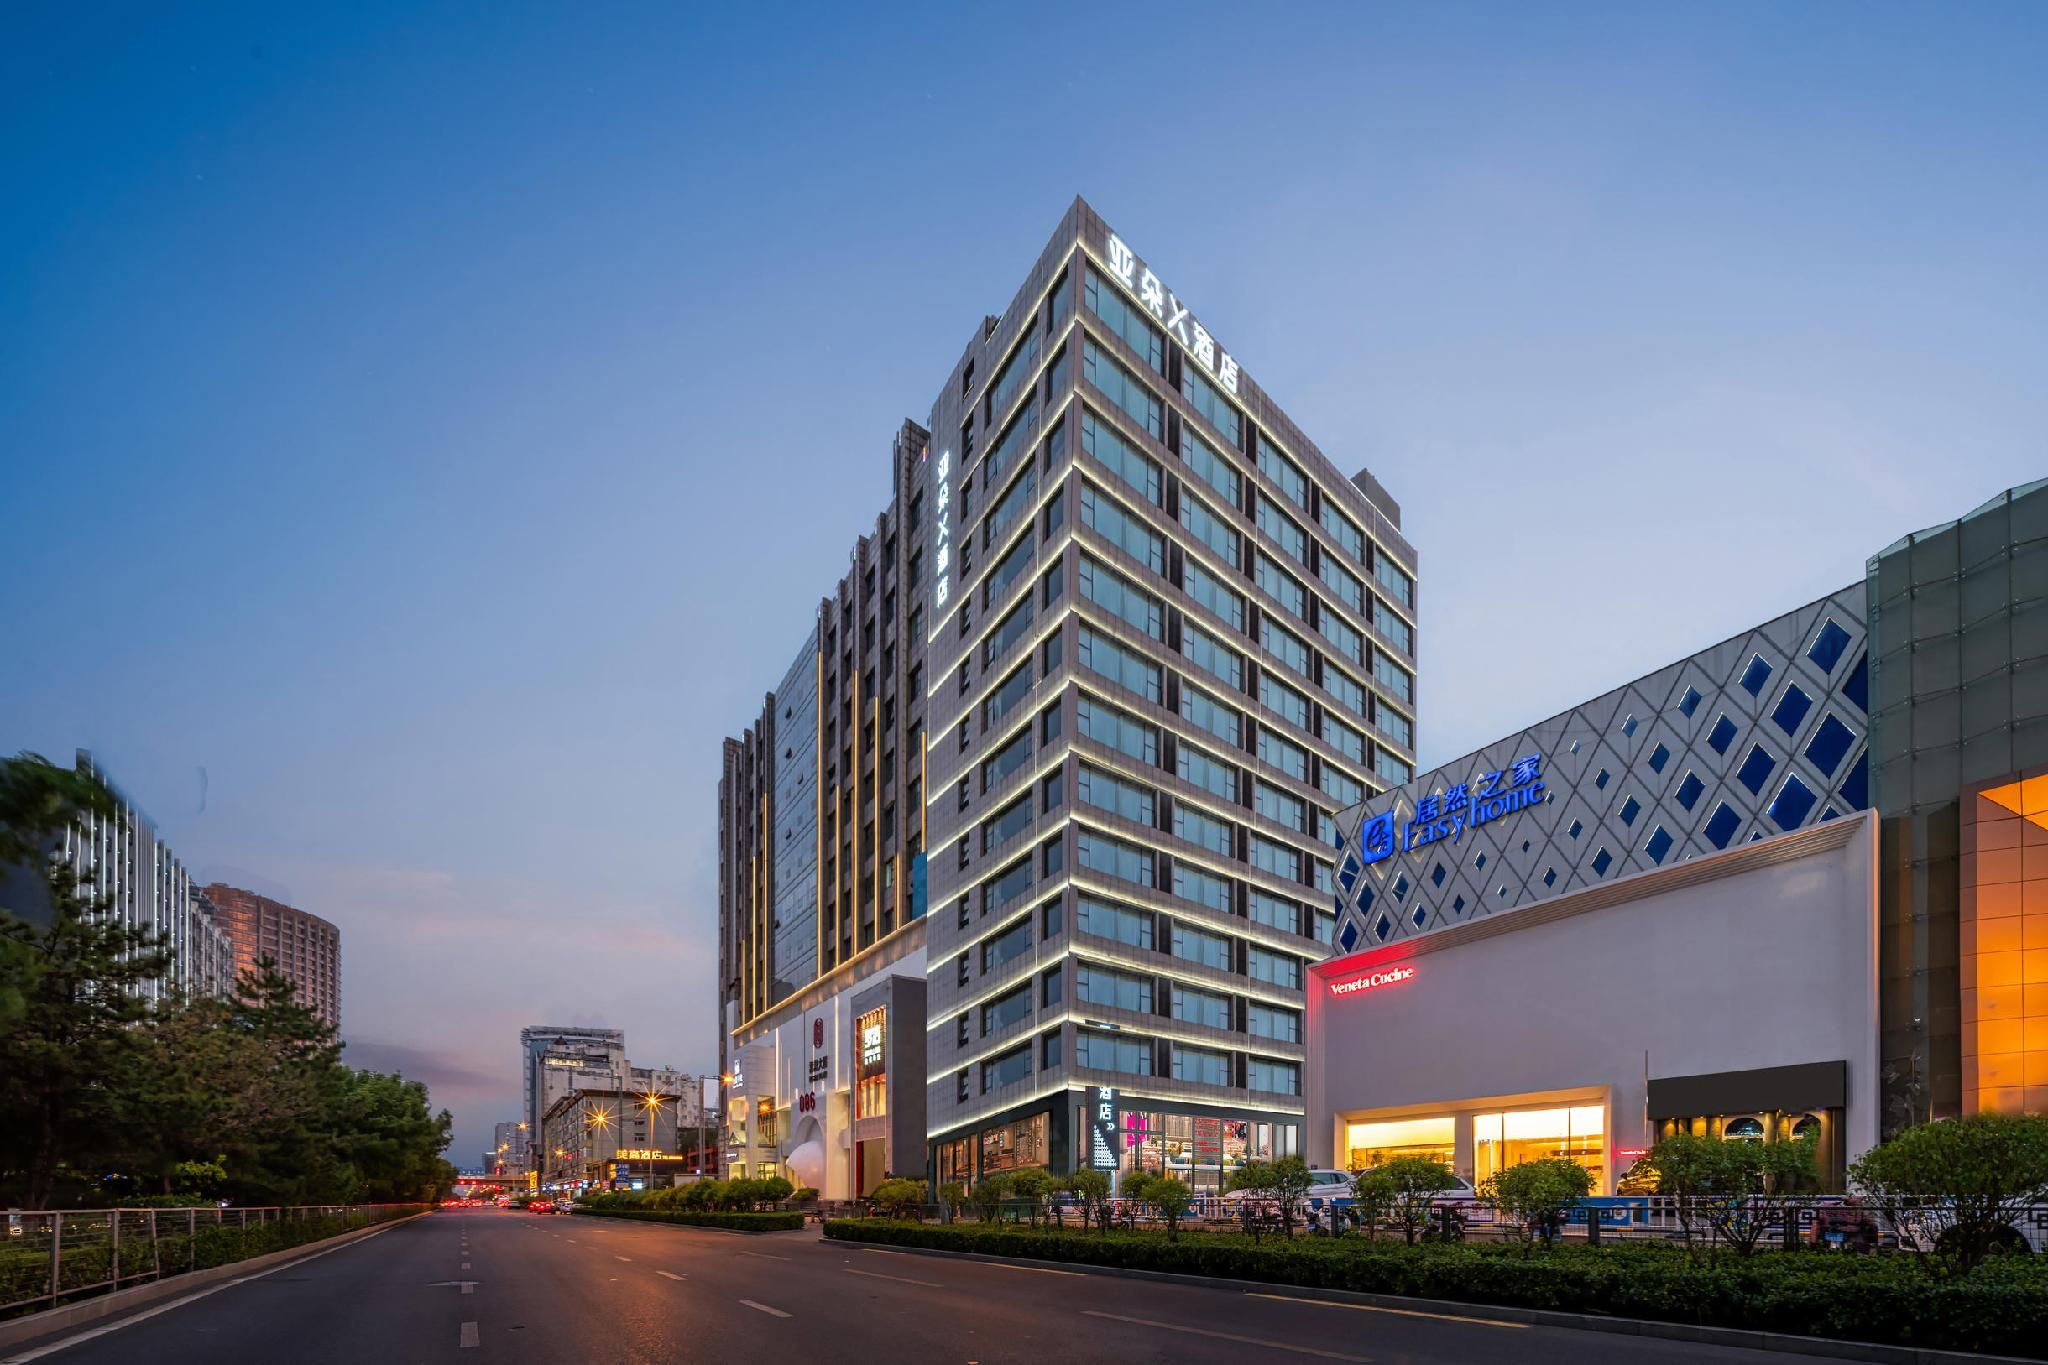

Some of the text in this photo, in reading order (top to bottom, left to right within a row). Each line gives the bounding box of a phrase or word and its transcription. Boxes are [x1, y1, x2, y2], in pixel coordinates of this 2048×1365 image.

[1415, 752, 1542, 825] 居然之家
[1331, 967, 1413, 995] Veneta Cucine
[1099, 1086, 1112, 1119] 酒店
